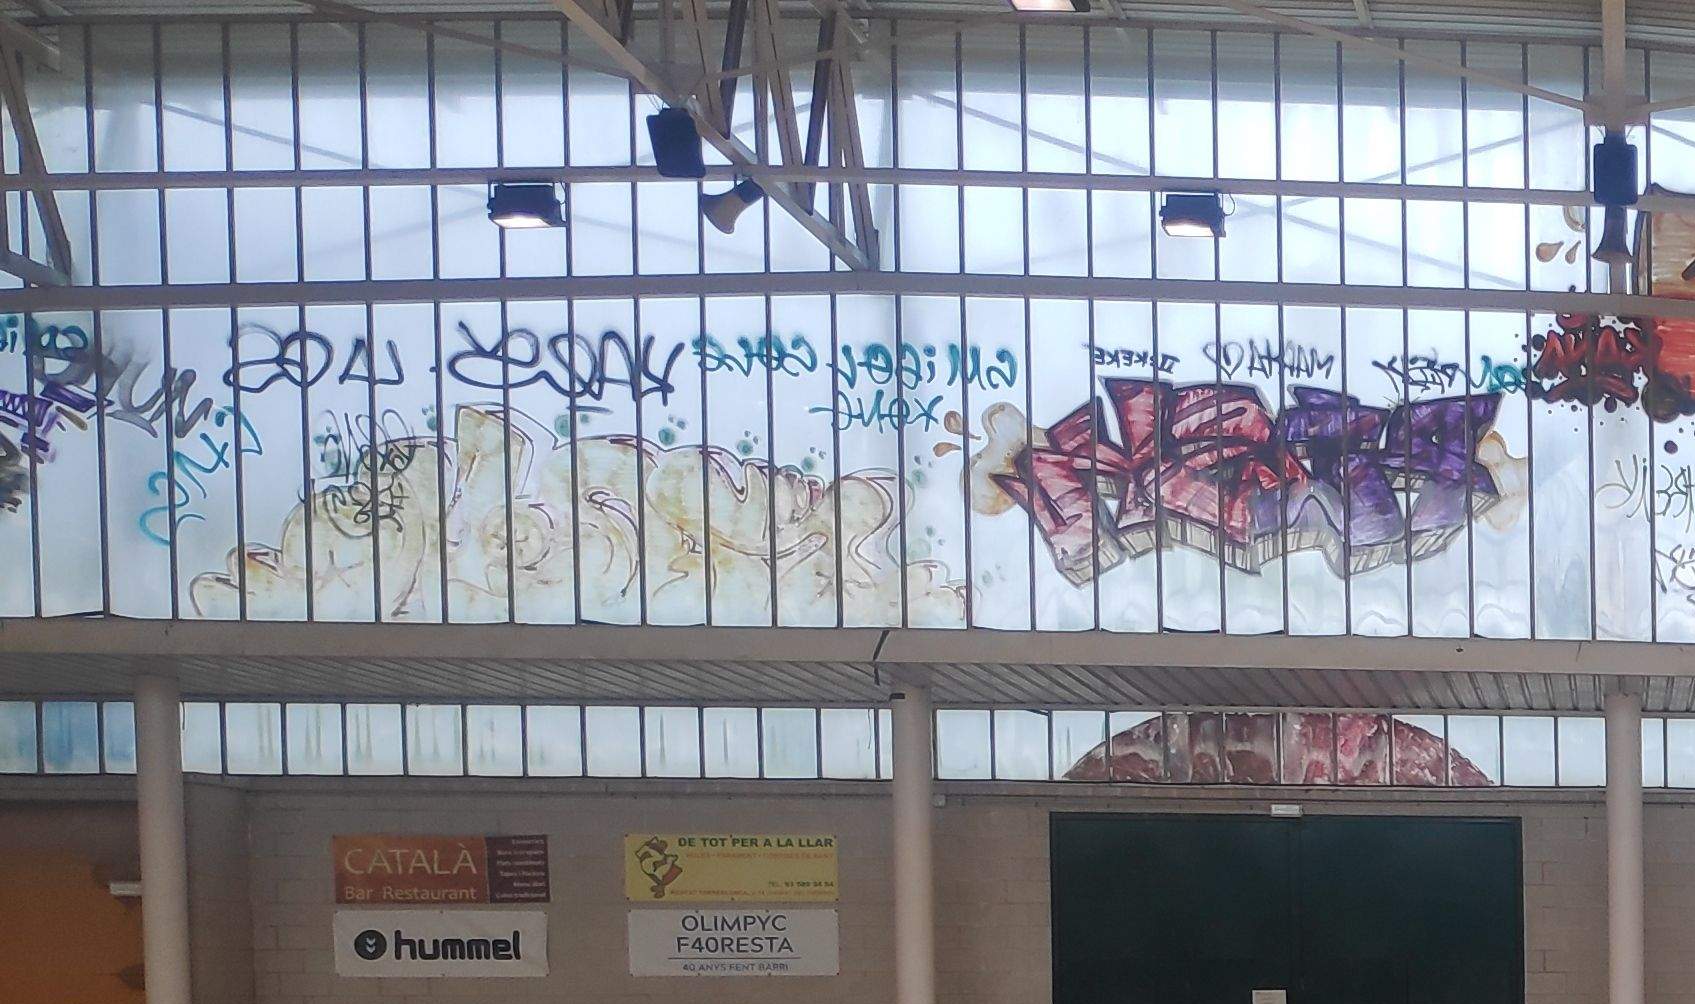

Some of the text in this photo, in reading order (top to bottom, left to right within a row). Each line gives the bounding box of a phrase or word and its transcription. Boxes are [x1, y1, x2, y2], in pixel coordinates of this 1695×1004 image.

[678, 837, 834, 848] DE TOT PER A LA LLAR
[343, 842, 478, 876] CATALÀ
[344, 885, 372, 900] Bar
[383, 885, 477, 901] Restaurant
[681, 914, 787, 933] OLIMPYC
[393, 929, 521, 960] hummel
[676, 936, 795, 955] F40RESTA
[682, 963, 789, 972] 40 ANYS FENT BARRI
